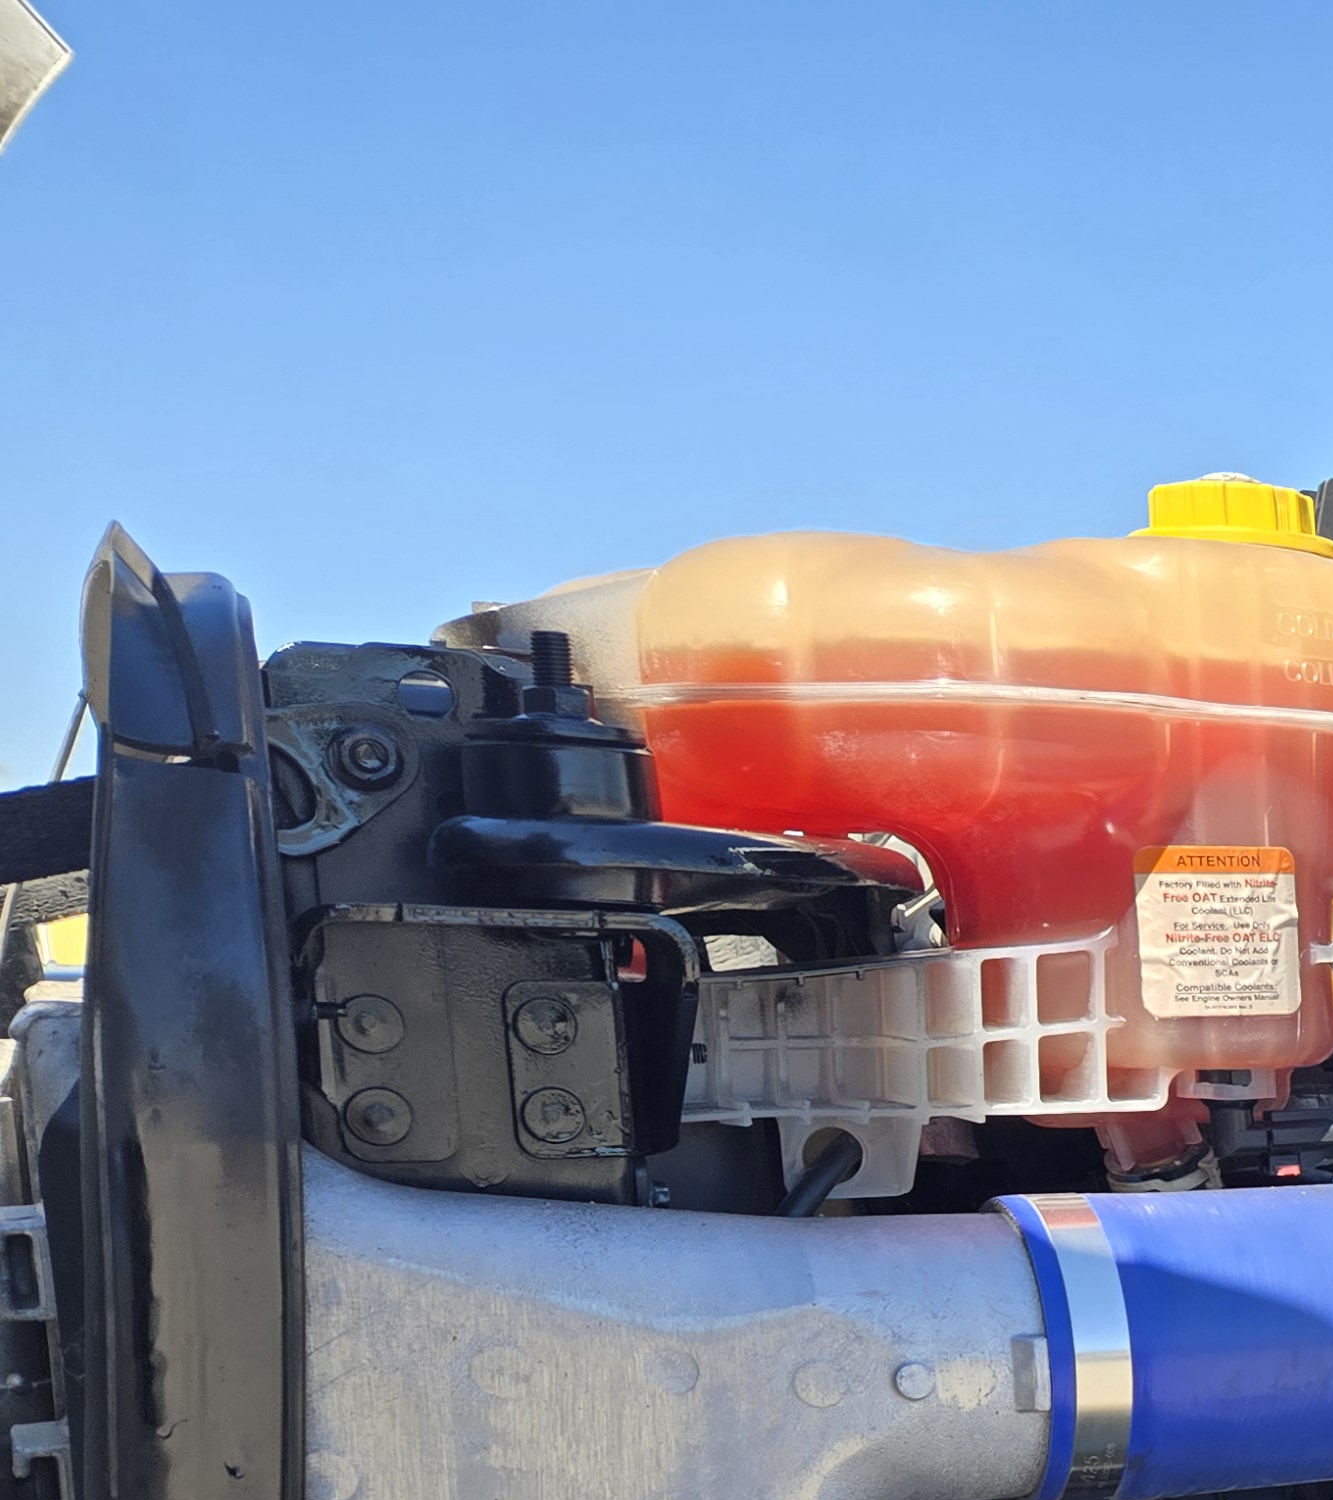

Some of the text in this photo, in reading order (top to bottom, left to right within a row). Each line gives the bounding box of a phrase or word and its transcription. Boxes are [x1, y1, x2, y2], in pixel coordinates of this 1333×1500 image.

[1176, 855, 1262, 868] ATTENTION
[1159, 880, 1193, 890] Factory
[1196, 880, 1221, 888] Filled
[1223, 879, 1242, 888] with
[1163, 893, 1276, 903] Free OAT Extended Life
[1191, 906, 1254, 917] Coolant (ELC)
[1174, 922, 1189, 931] For
[1233, 921, 1251, 931] Use
[1252, 920, 1270, 931] Only
[1166, 931, 1280, 944] Nitrite-Free OAT ELC
[1220, 947, 1232, 955] Do
[1235, 947, 1250, 955] Not
[1252, 946, 1269, 955] Add
[1168, 958, 1229, 968] Conventional
[1231, 957, 1268, 967] Coolants
[1215, 969, 1239, 978] SCAs
[1176, 983, 1232, 993] Compatible
[1174, 993, 1280, 1004] See Engine Owners Manual
